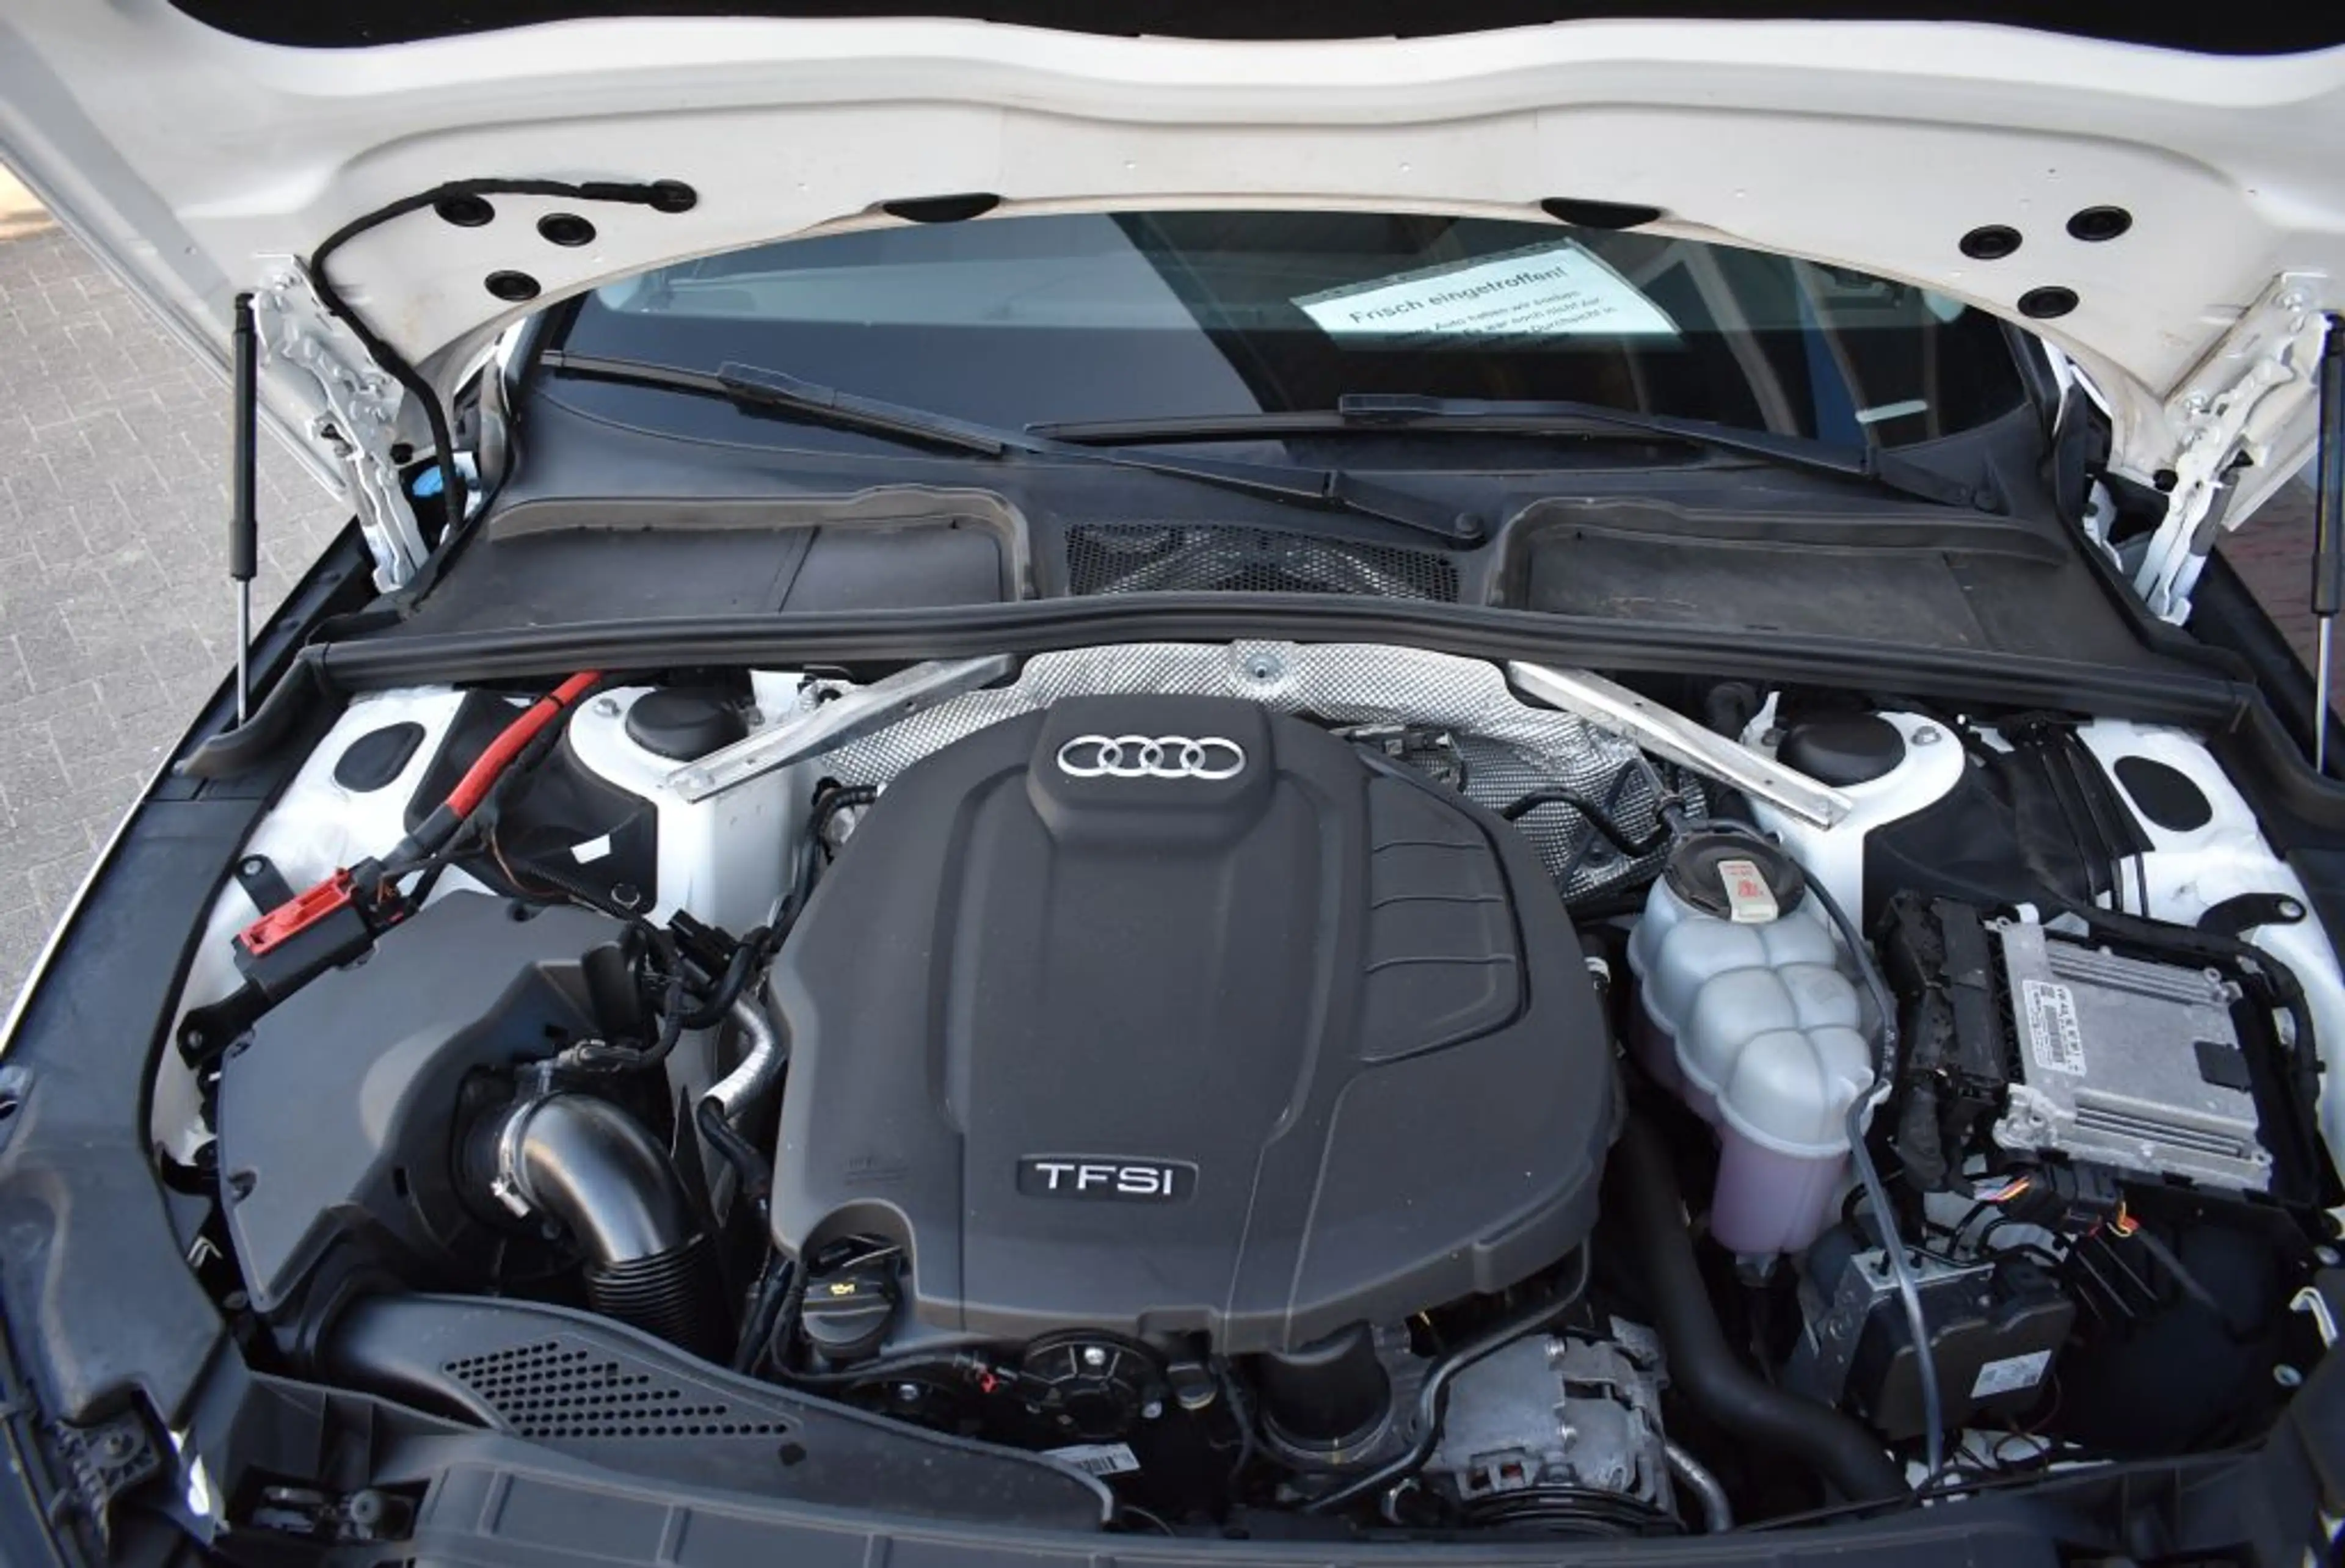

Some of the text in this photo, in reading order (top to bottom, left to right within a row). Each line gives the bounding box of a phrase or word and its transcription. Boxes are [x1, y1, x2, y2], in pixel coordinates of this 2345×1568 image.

[1349, 265, 1568, 324] Frisch eingetroffen!
[1035, 1163, 1172, 1196] TFSI
